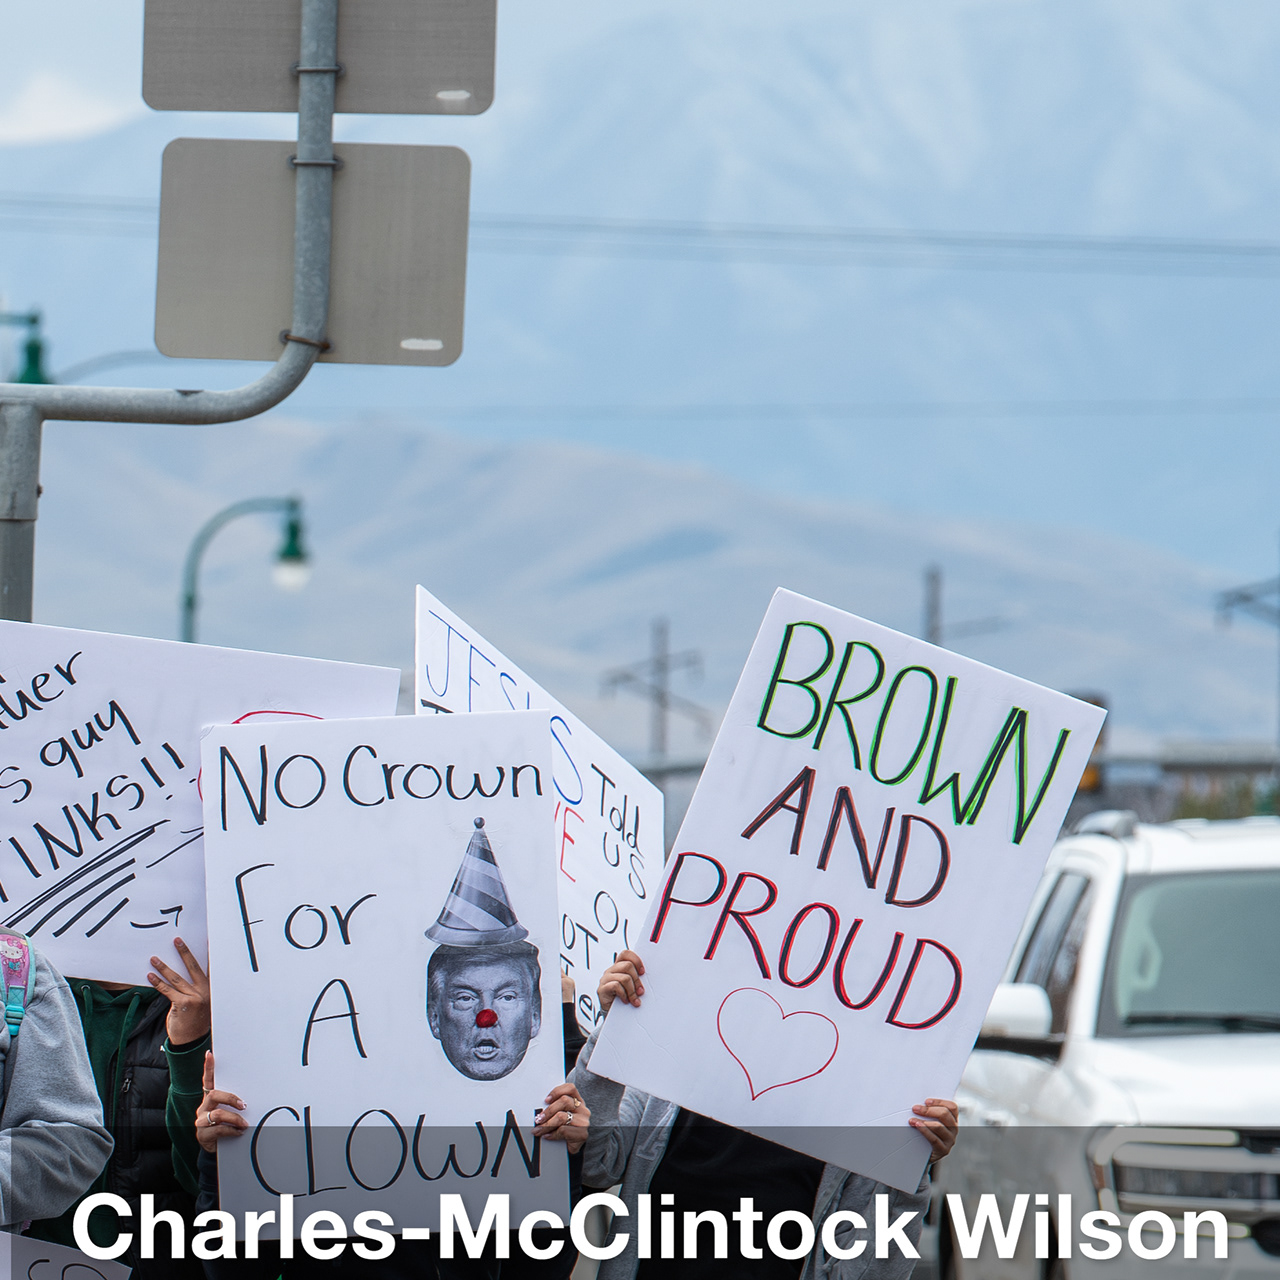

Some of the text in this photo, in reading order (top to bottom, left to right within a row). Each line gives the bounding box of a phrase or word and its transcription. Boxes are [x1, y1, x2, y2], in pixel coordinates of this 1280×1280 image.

[39, 699, 142, 780] guy
[343, 744, 543, 808] Crown
[757, 620, 1071, 846] BROWN
[591, 763, 645, 858] Told
[741, 766, 950, 909] AND
[235, 862, 378, 972] For
[650, 851, 963, 1031] PROUD
[301, 977, 368, 1067] A
[250, 1104, 543, 1198] CLOWN
